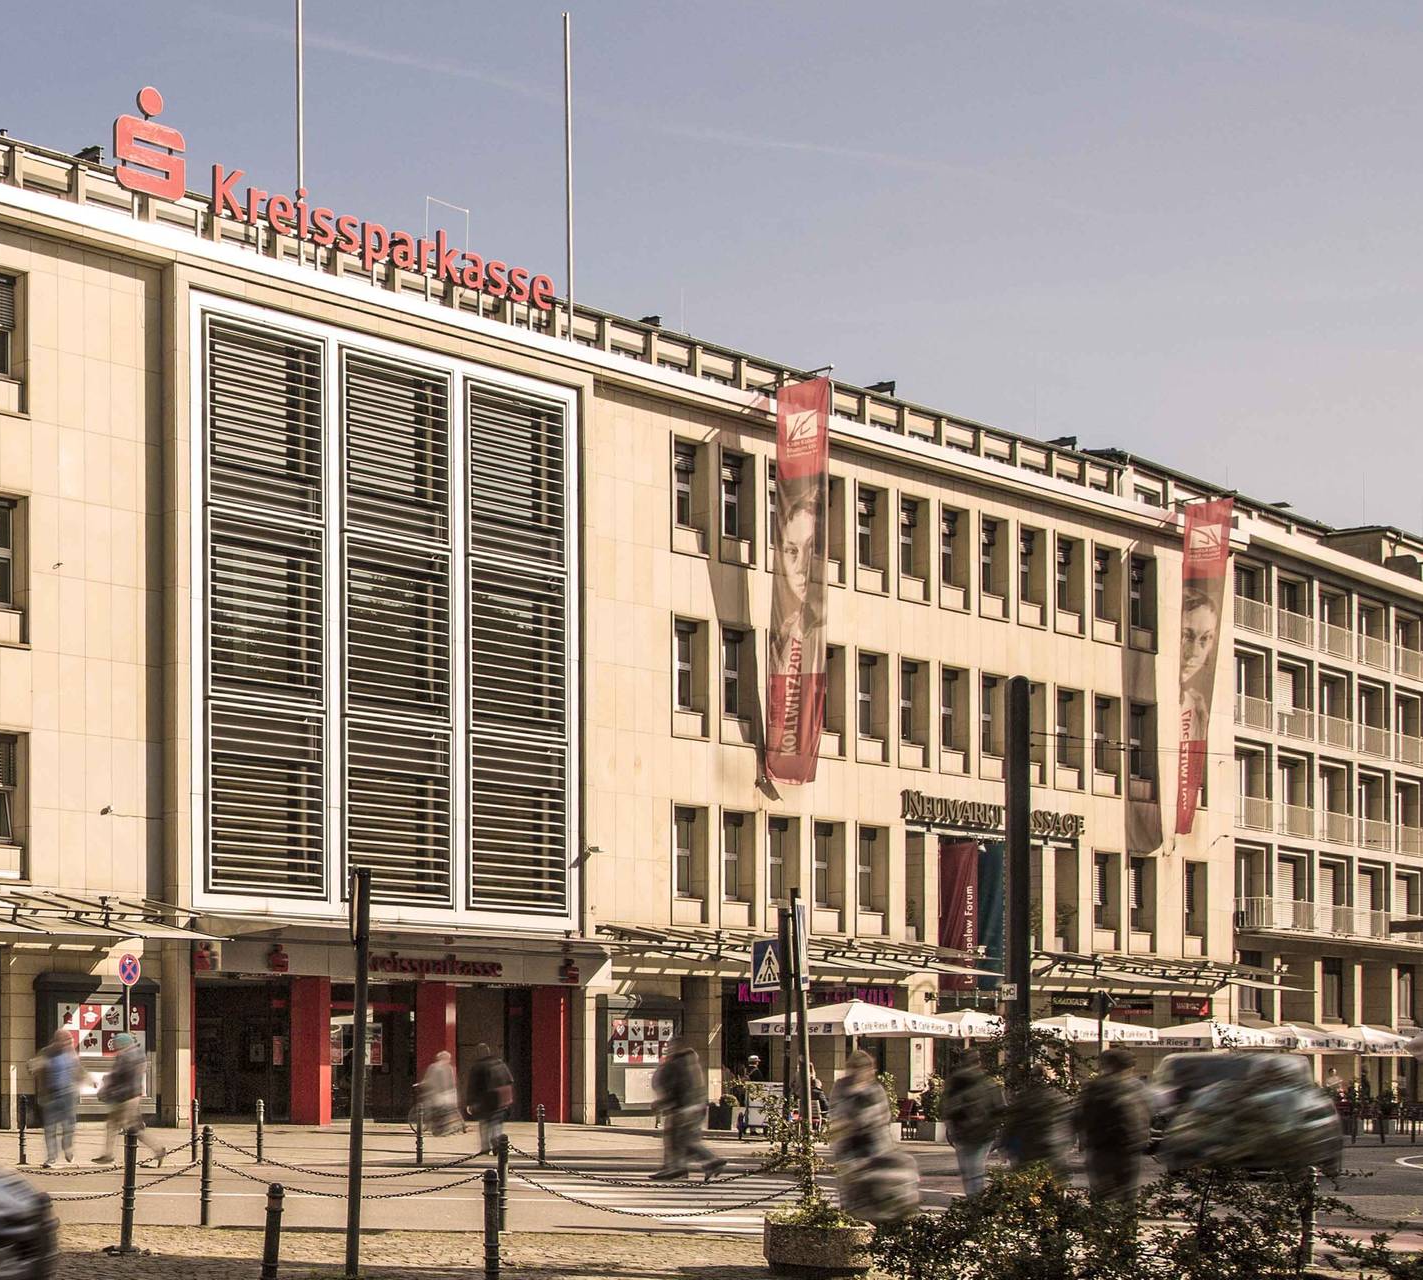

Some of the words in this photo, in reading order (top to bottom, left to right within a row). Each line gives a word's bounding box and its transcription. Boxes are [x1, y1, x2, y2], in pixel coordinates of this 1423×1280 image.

[212, 164, 555, 311] Kreissparkasse
[788, 638, 802, 673] 2017
[780, 676, 802, 756] KOLLWITZ
[900, 788, 1006, 825] NEUMARKT
[1030, 809, 1085, 836] SSAGE
[964, 886, 973, 916] Forum
[963, 920, 975, 961] opelew
[1166, 1038, 1188, 1046] Riese
